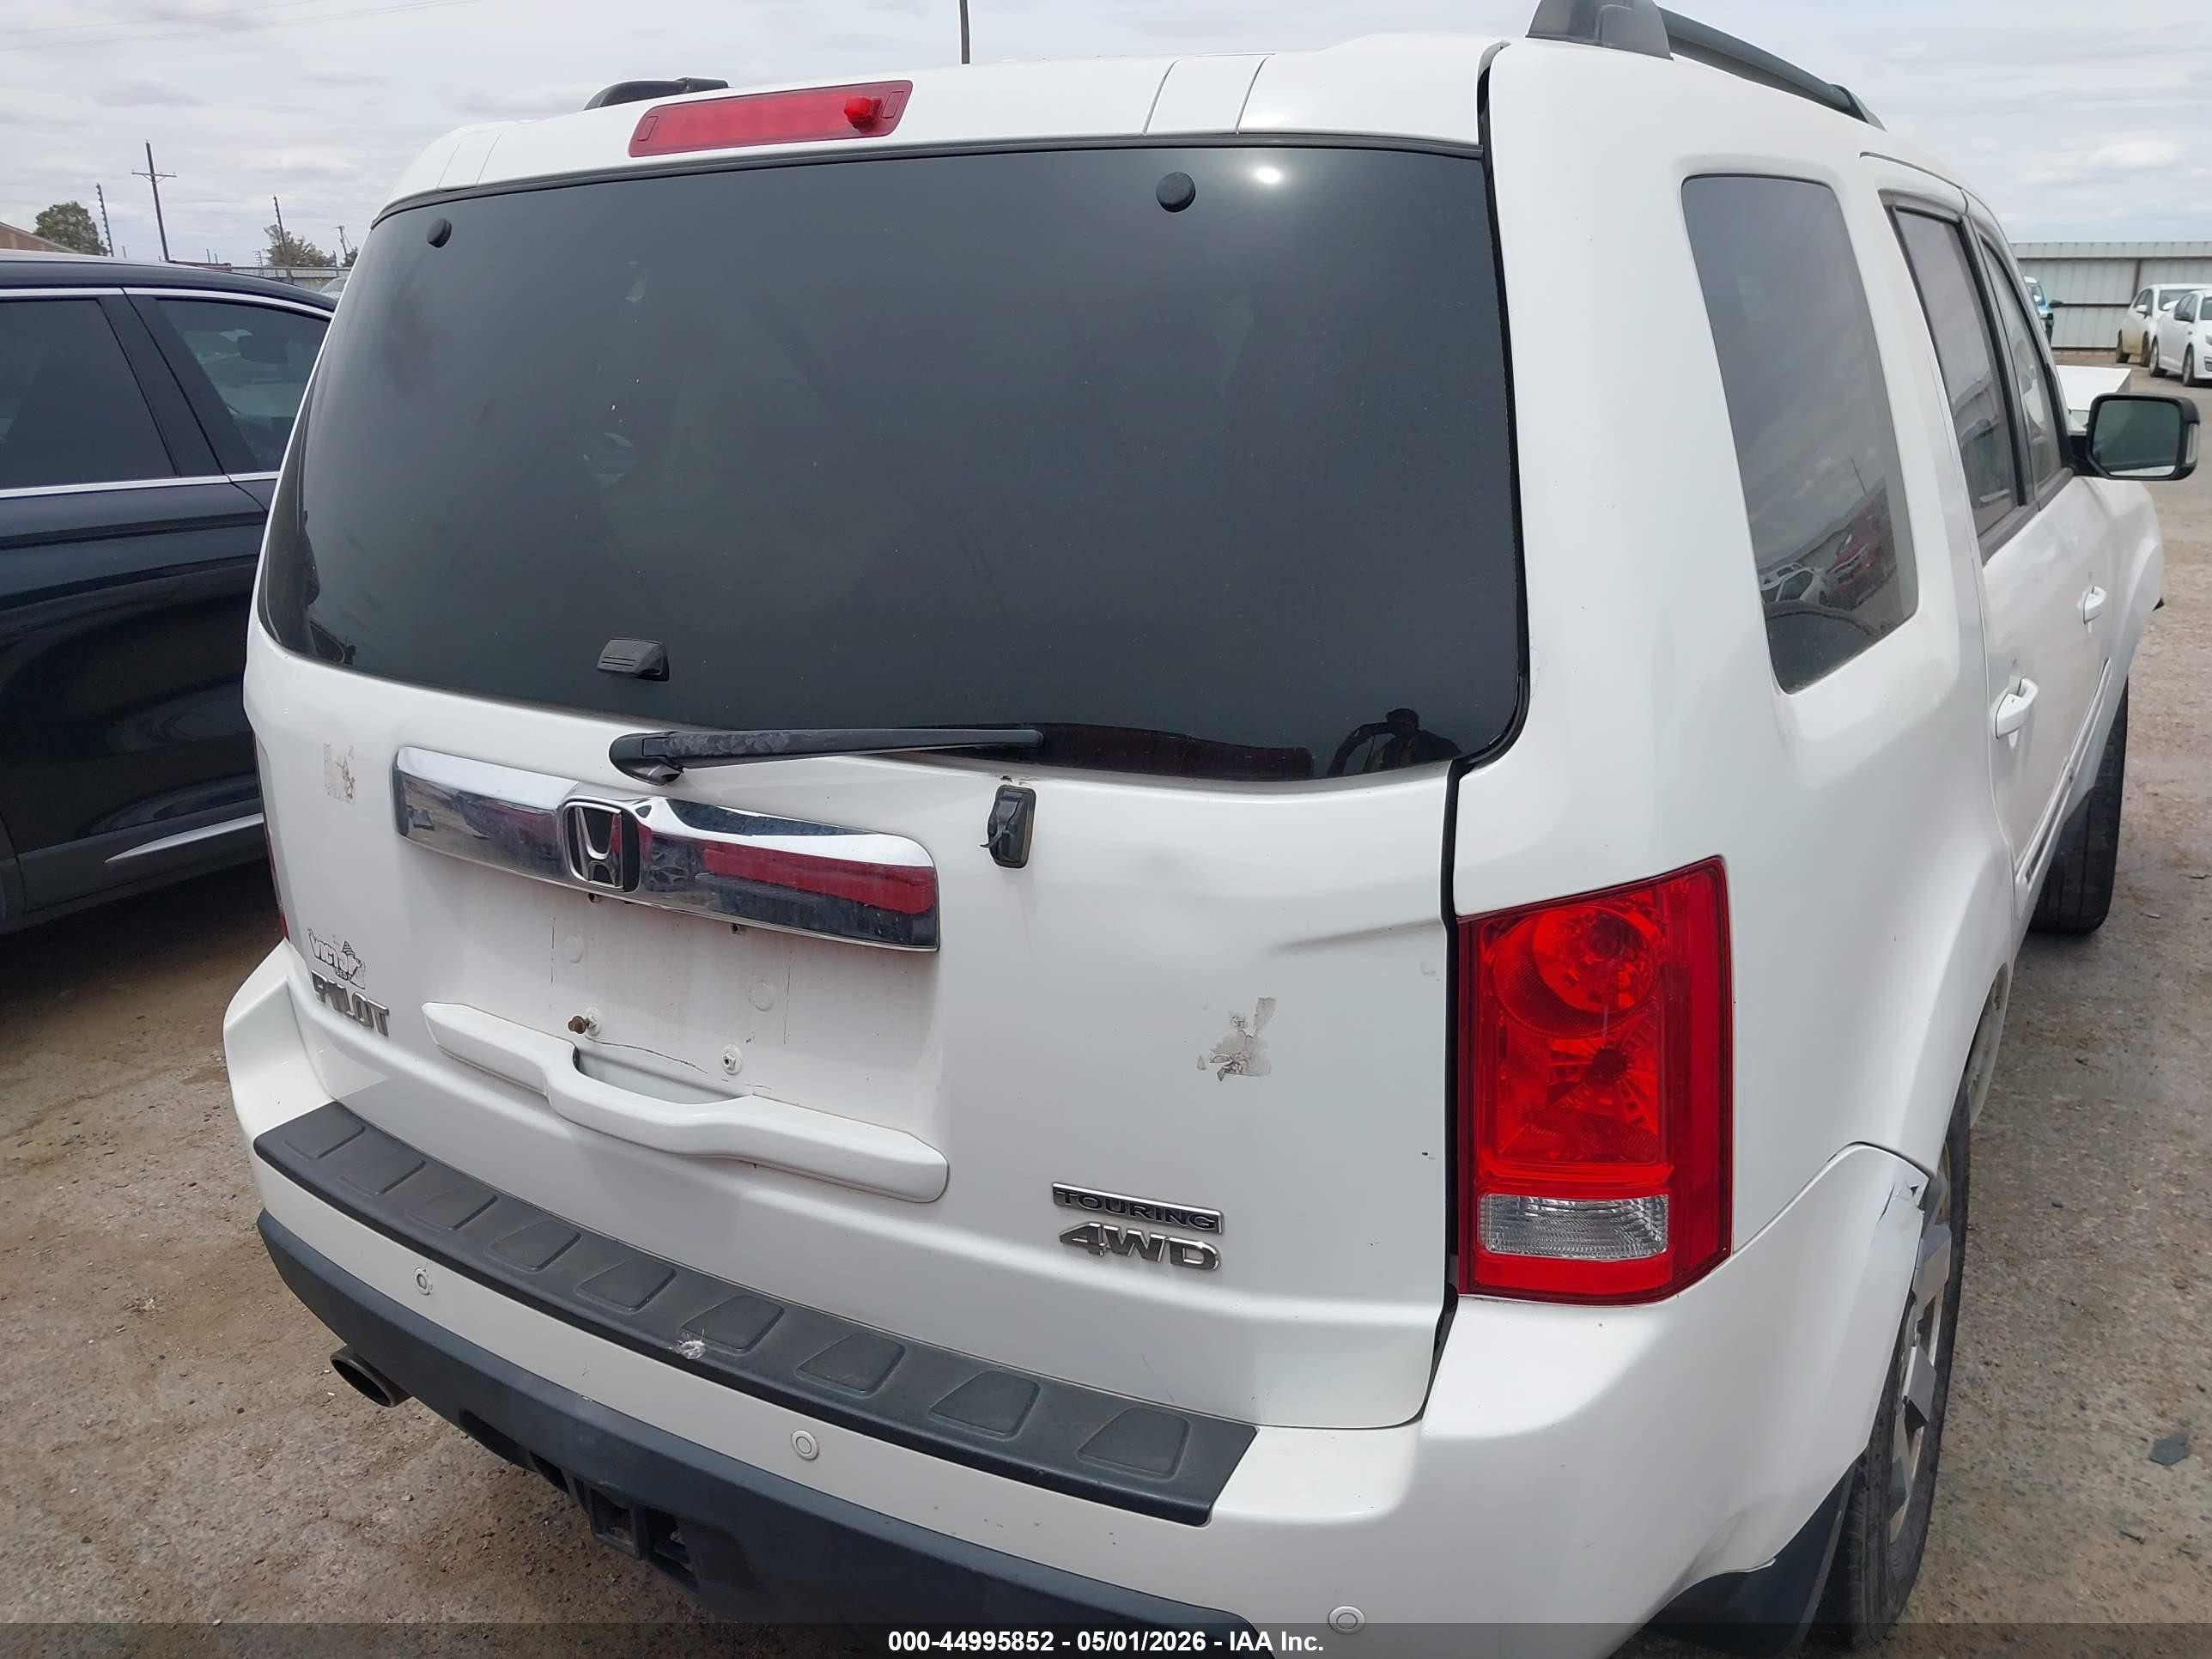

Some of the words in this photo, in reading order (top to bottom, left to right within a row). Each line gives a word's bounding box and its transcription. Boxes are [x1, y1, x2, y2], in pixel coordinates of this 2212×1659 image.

[311, 969, 390, 1038] PILOT
[1055, 1190, 1217, 1231] TOURING
[1059, 1221, 1221, 1271] 4WD
